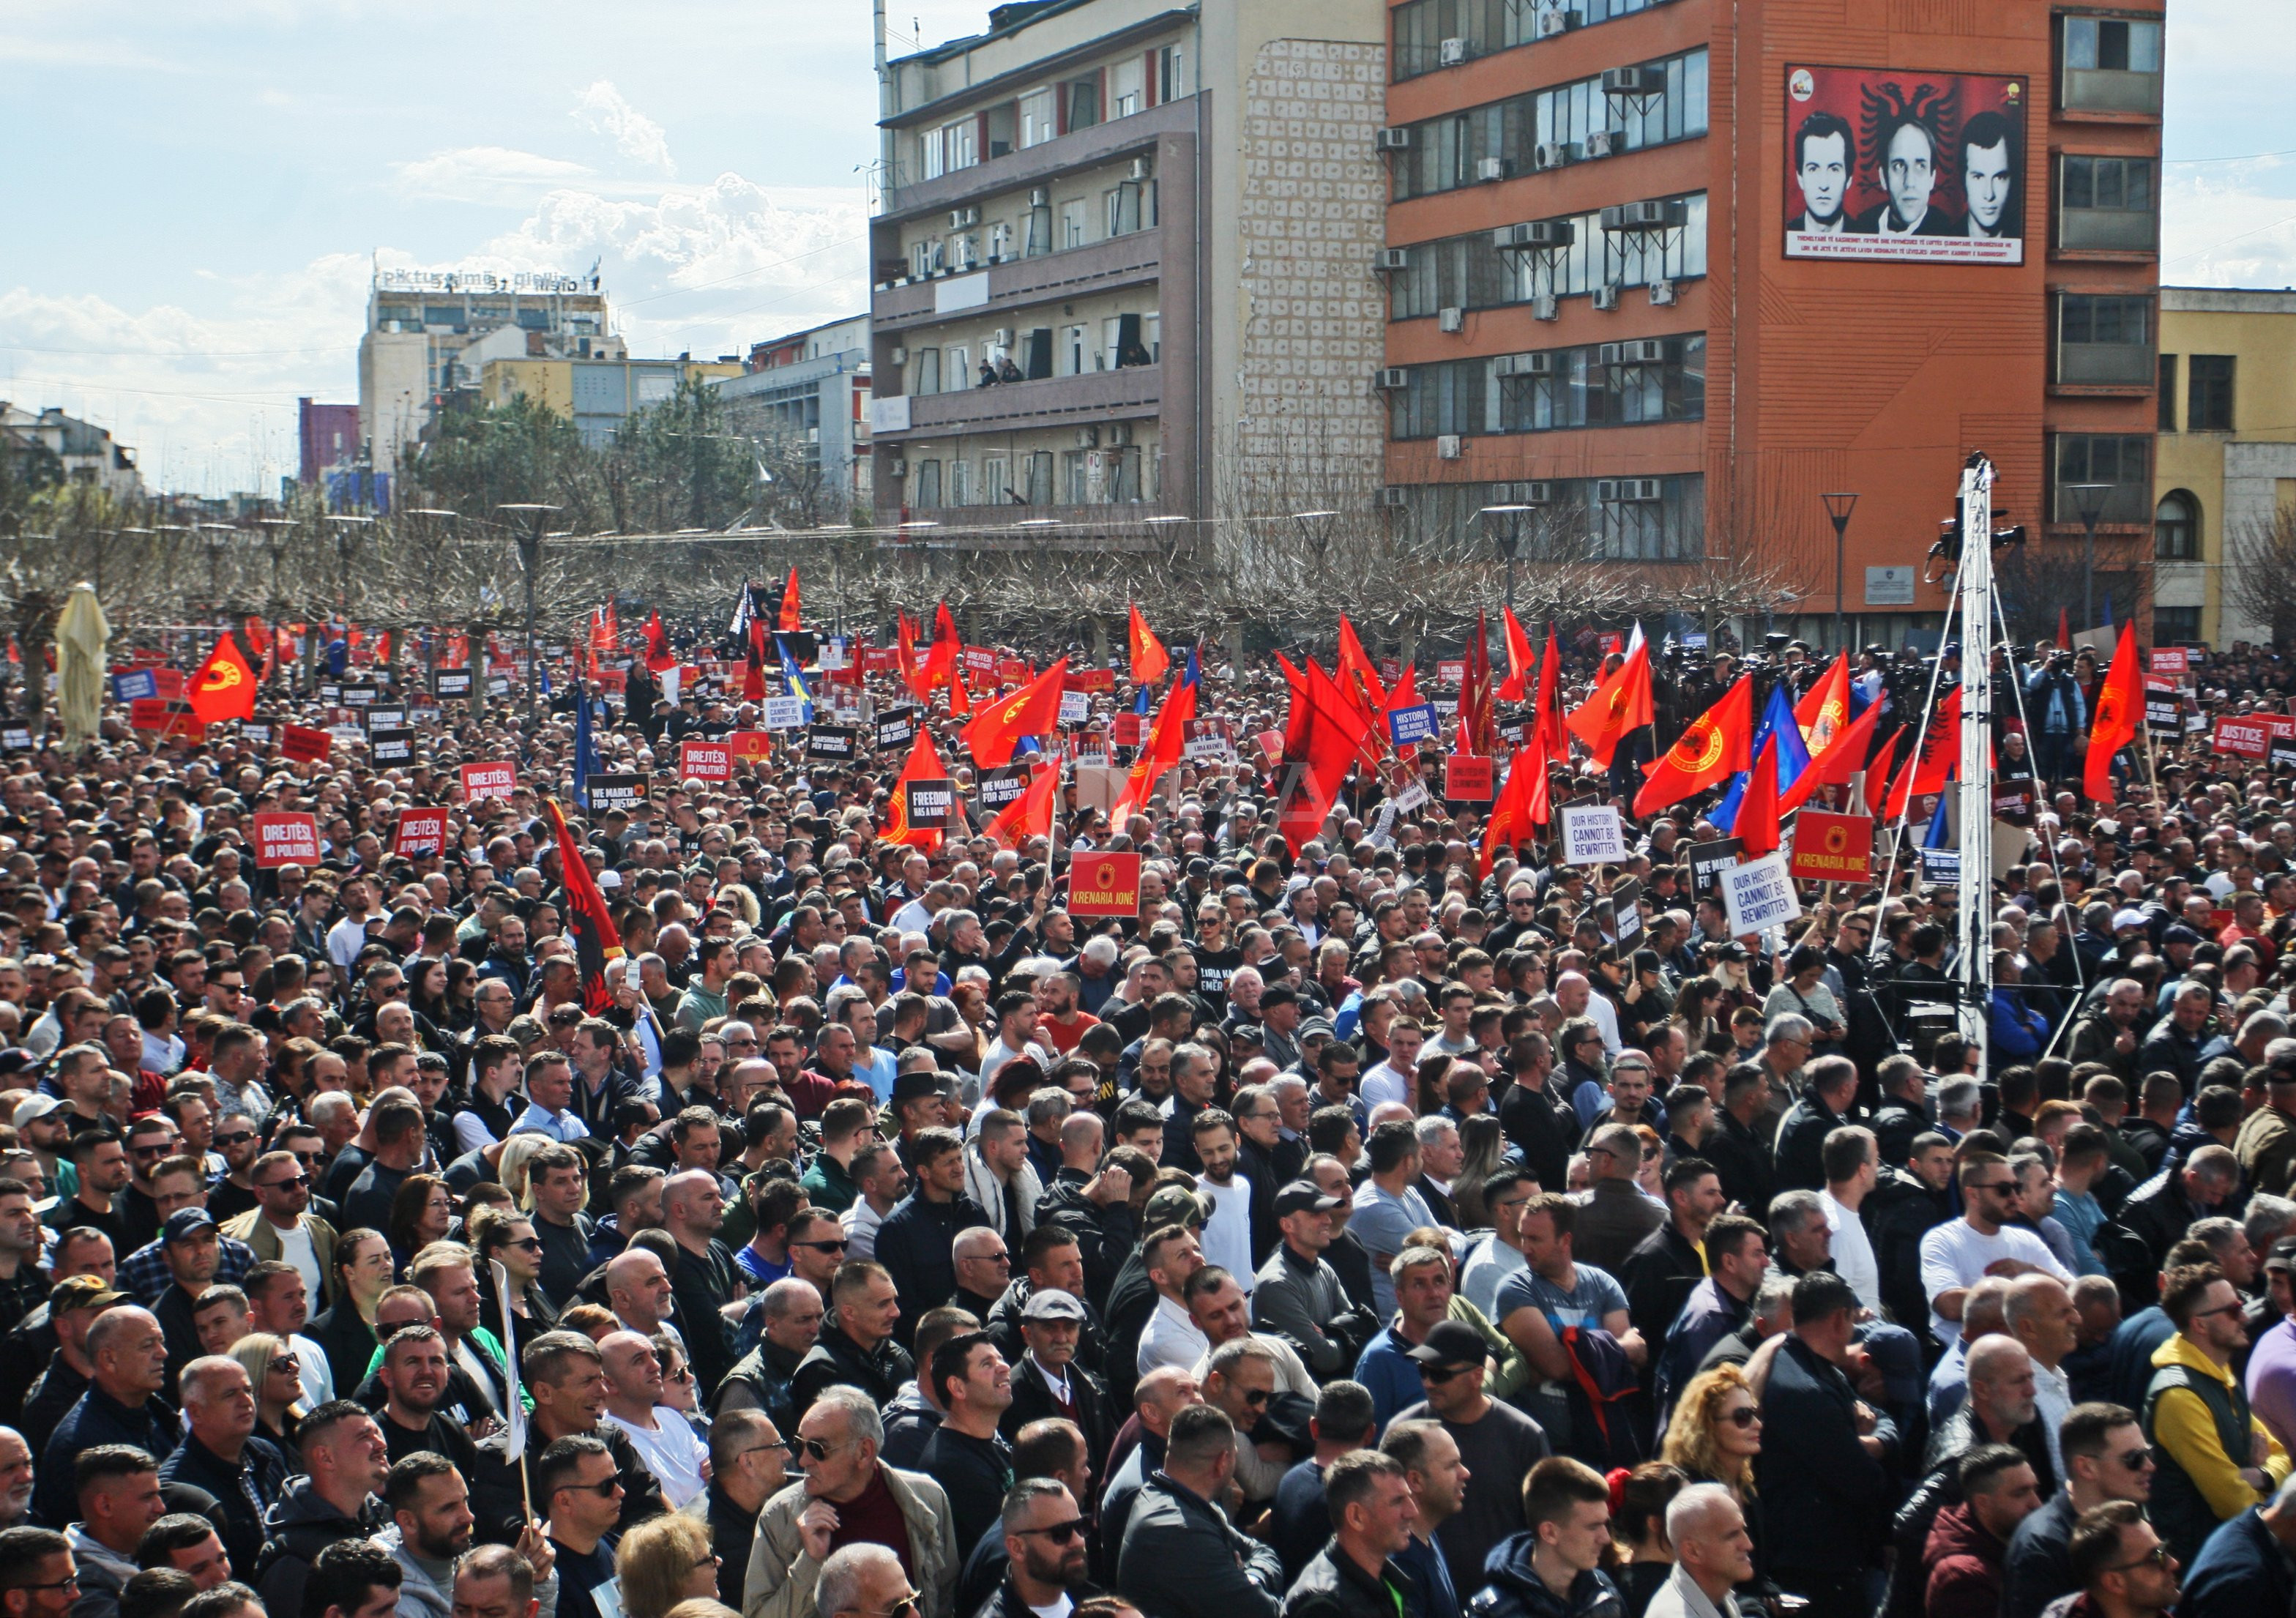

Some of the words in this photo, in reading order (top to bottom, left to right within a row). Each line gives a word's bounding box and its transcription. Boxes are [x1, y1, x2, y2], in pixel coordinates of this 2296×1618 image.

[1396, 709, 1429, 725] HISTORIA
[880, 724, 889, 734] WE
[889, 720, 906, 732] MARCH
[687, 749, 727, 764] DREJTËSI,
[686, 764, 696, 773] JO
[696, 765, 726, 775] POLITIKË!
[468, 769, 512, 786] DREJTËSI,
[982, 781, 996, 791] WE
[996, 778, 1018, 789] MARCH
[592, 788, 605, 798] WE
[605, 787, 634, 797] MARCH
[913, 791, 952, 806] FREEDOM
[983, 790, 996, 803] FOR
[592, 799, 608, 809] FOR
[914, 807, 925, 816] HAS
[926, 807, 931, 816] A
[931, 806, 944, 816] NAME
[401, 817, 441, 837] DREJTËSI,
[1571, 817, 1586, 827] OUR
[1587, 814, 1612, 826] HISTORY
[263, 821, 314, 841] DREJTËSI,
[1573, 829, 1604, 842] CANNOT
[1606, 828, 1616, 840] BE
[265, 845, 276, 857] JO
[277, 842, 315, 857] POLITIKË!
[399, 840, 407, 852] JO
[1575, 843, 1617, 856] REWRITTEN
[1696, 860, 1711, 874] WE
[1796, 853, 1844, 870] KRENARIA
[1845, 855, 1867, 872] JONË
[1734, 874, 1749, 890] OUR
[1750, 865, 1780, 885] HISTORY
[1072, 891, 1113, 905] KRENARIA
[1115, 888, 1135, 906] JONË
[1737, 884, 1773, 906] CANNOT
[1774, 880, 1786, 895] BE
[1742, 898, 1789, 924] REWRITTEN
[1201, 968, 1221, 979] LIRIA
[1223, 969, 1232, 979] KA
[1201, 980, 1223, 991] EMËR
